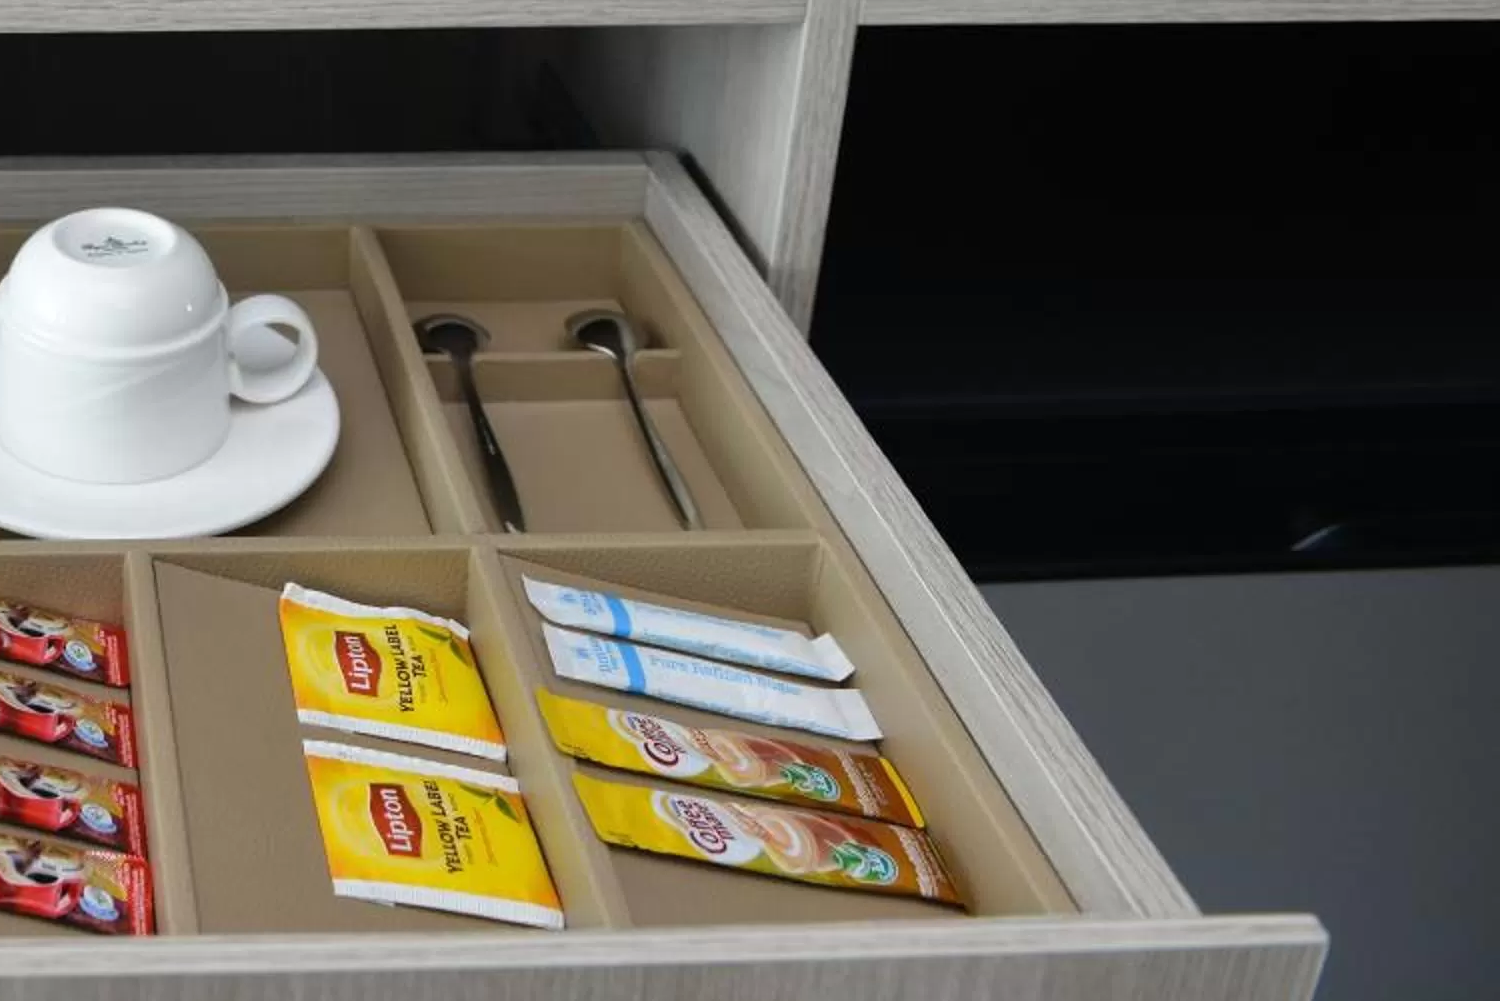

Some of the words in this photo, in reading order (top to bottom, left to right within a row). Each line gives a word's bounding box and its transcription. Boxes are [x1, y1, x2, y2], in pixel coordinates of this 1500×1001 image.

[344, 635, 373, 690] Lipton
[384, 624, 404, 656] LABEL
[411, 654, 428, 678] TEA
[394, 658, 414, 712] YELLOW
[380, 788, 414, 852] Lipton
[436, 818, 463, 874] YELLOW
[453, 815, 472, 840] TEA
